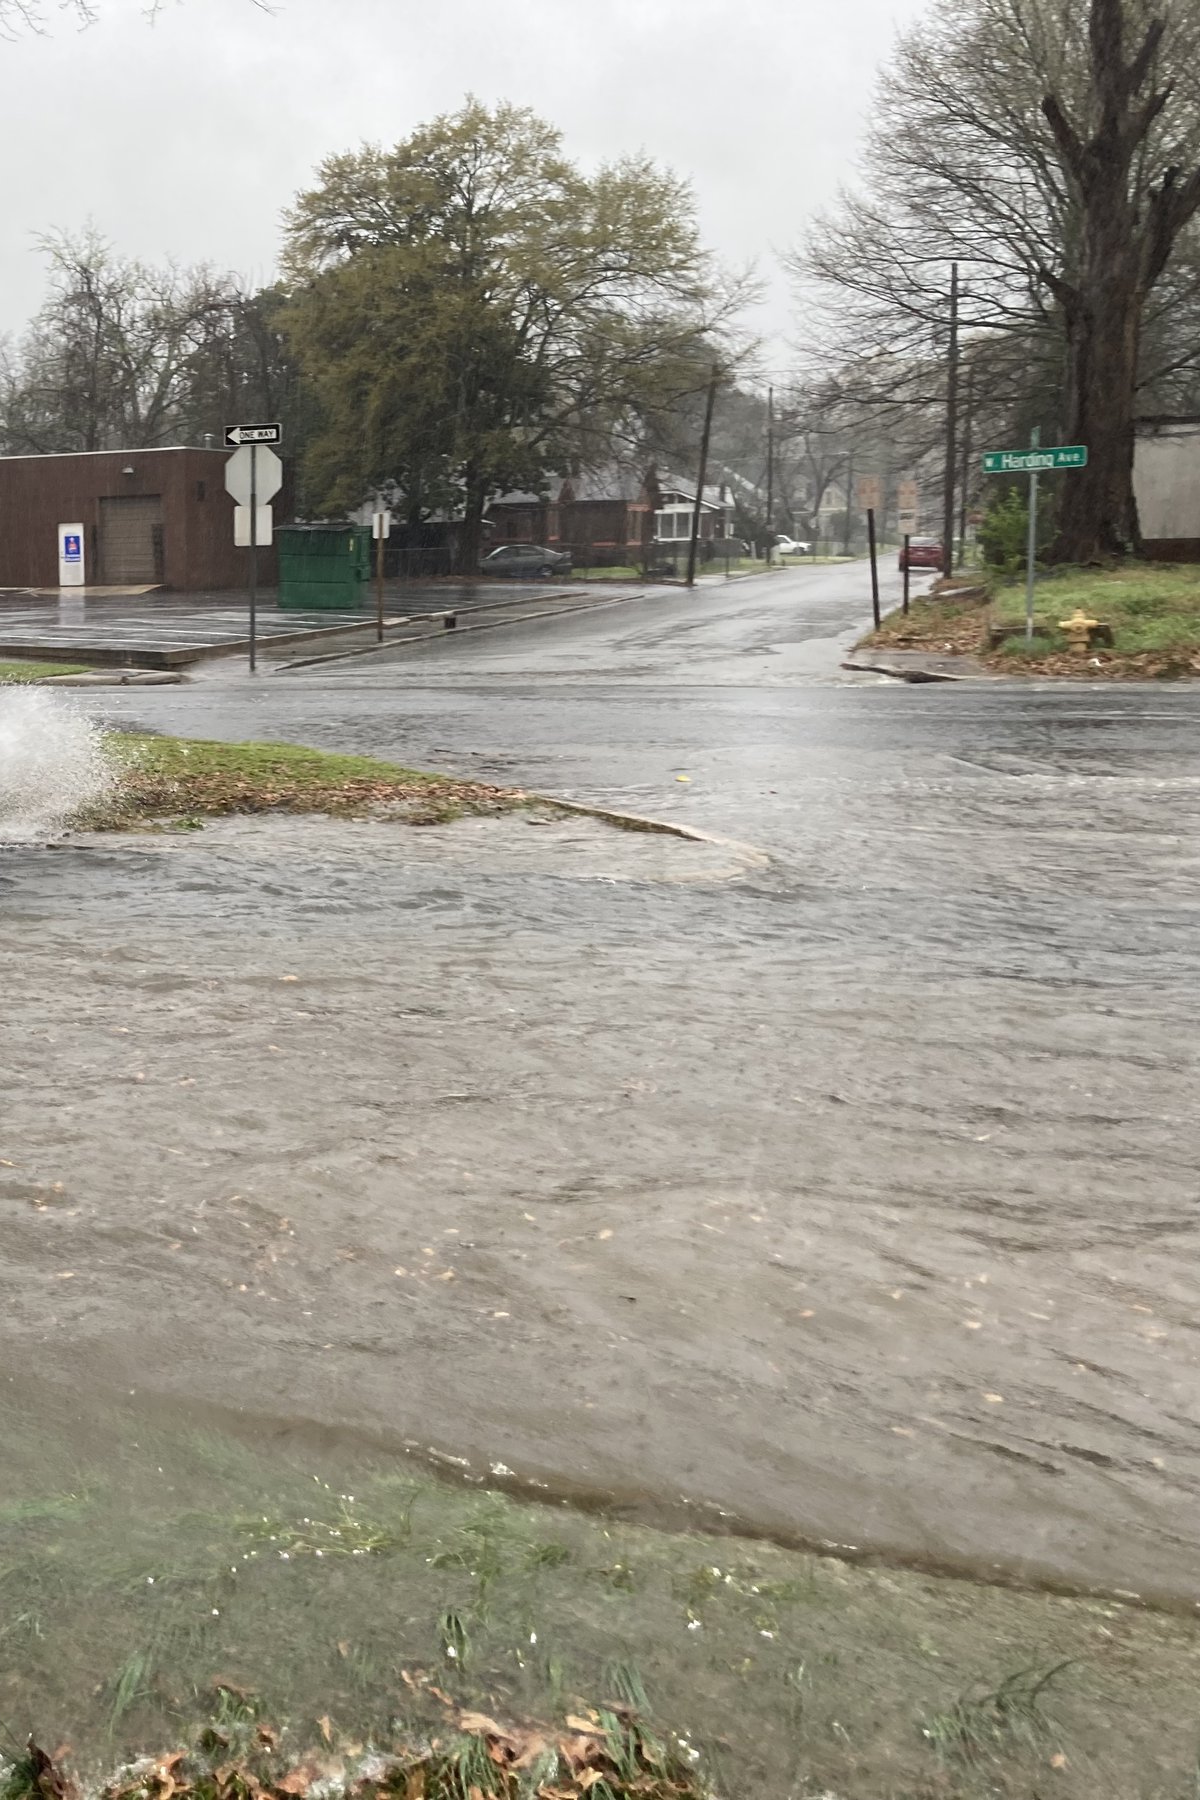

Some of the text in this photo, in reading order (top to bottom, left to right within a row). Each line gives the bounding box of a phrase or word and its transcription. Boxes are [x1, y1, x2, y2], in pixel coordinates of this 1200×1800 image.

[240, 430, 274, 439] ONE WAY
[1001, 453, 1054, 468] Harding
